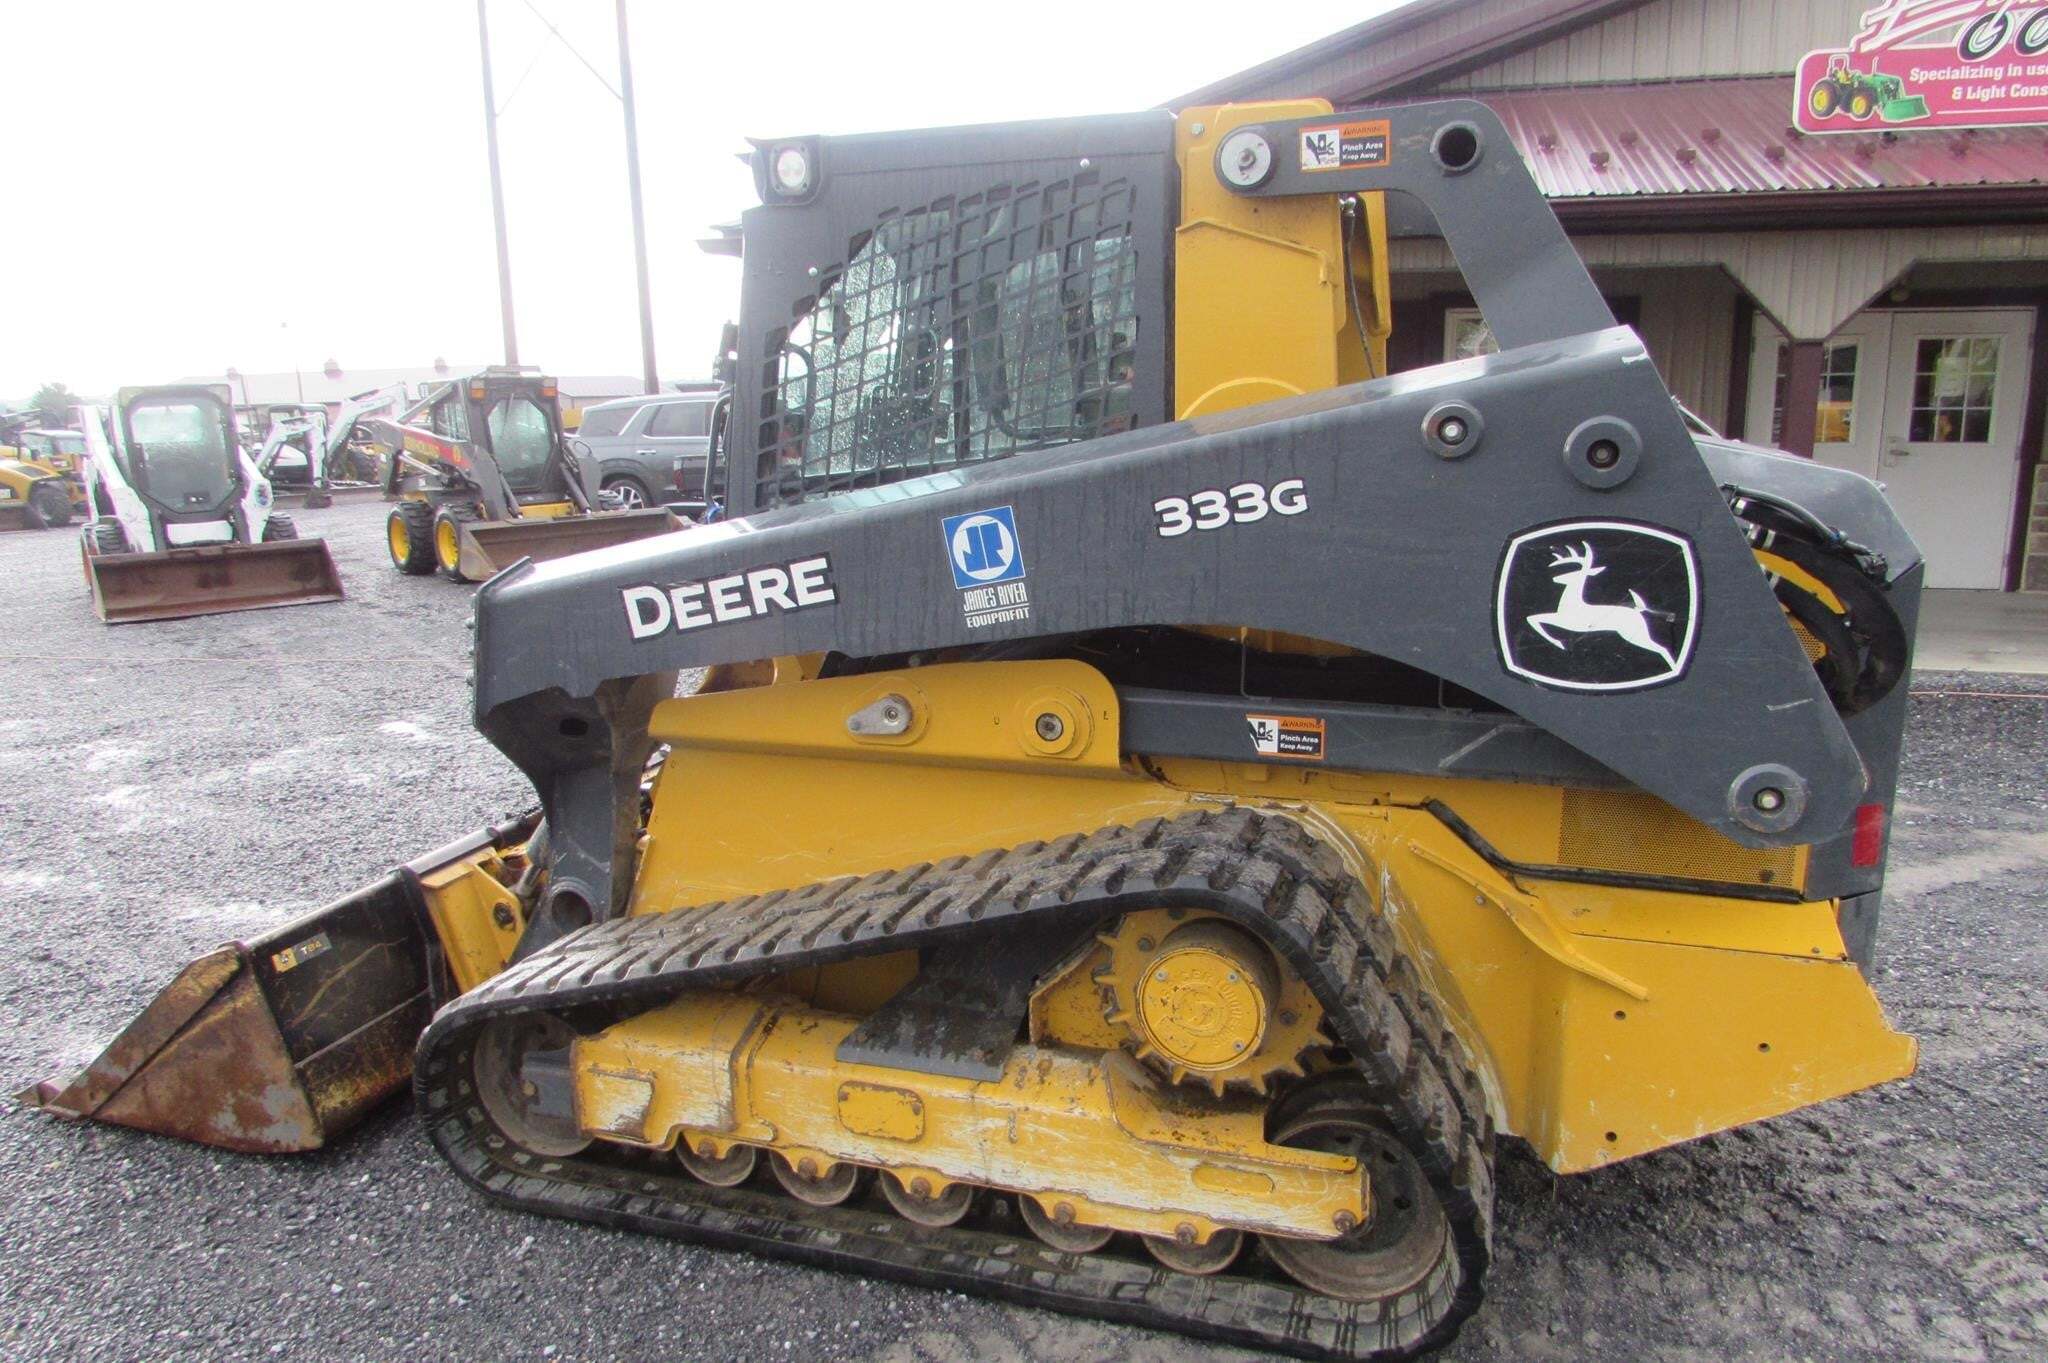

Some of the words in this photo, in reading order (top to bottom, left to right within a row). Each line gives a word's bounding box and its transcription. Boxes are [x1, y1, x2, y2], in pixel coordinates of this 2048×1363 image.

[1909, 65, 2003, 84] Specializing
[2007, 63, 2022, 77] in
[1951, 86, 1963, 100] &
[1966, 83, 2006, 102] Light
[1342, 142, 1364, 152] Pinch
[1365, 142, 1383, 150] Area
[1360, 152, 1378, 160] Away
[1154, 479, 1309, 537] 333G
[622, 557, 836, 640] DEERE
[963, 587, 997, 612] JAMES
[997, 582, 1028, 607] RIVER
[966, 606, 1030, 628] EQUIPMENT
[1280, 734, 1301, 742] Pinch
[1302, 735, 1319, 743] Area
[1296, 744, 1313, 752] Away
